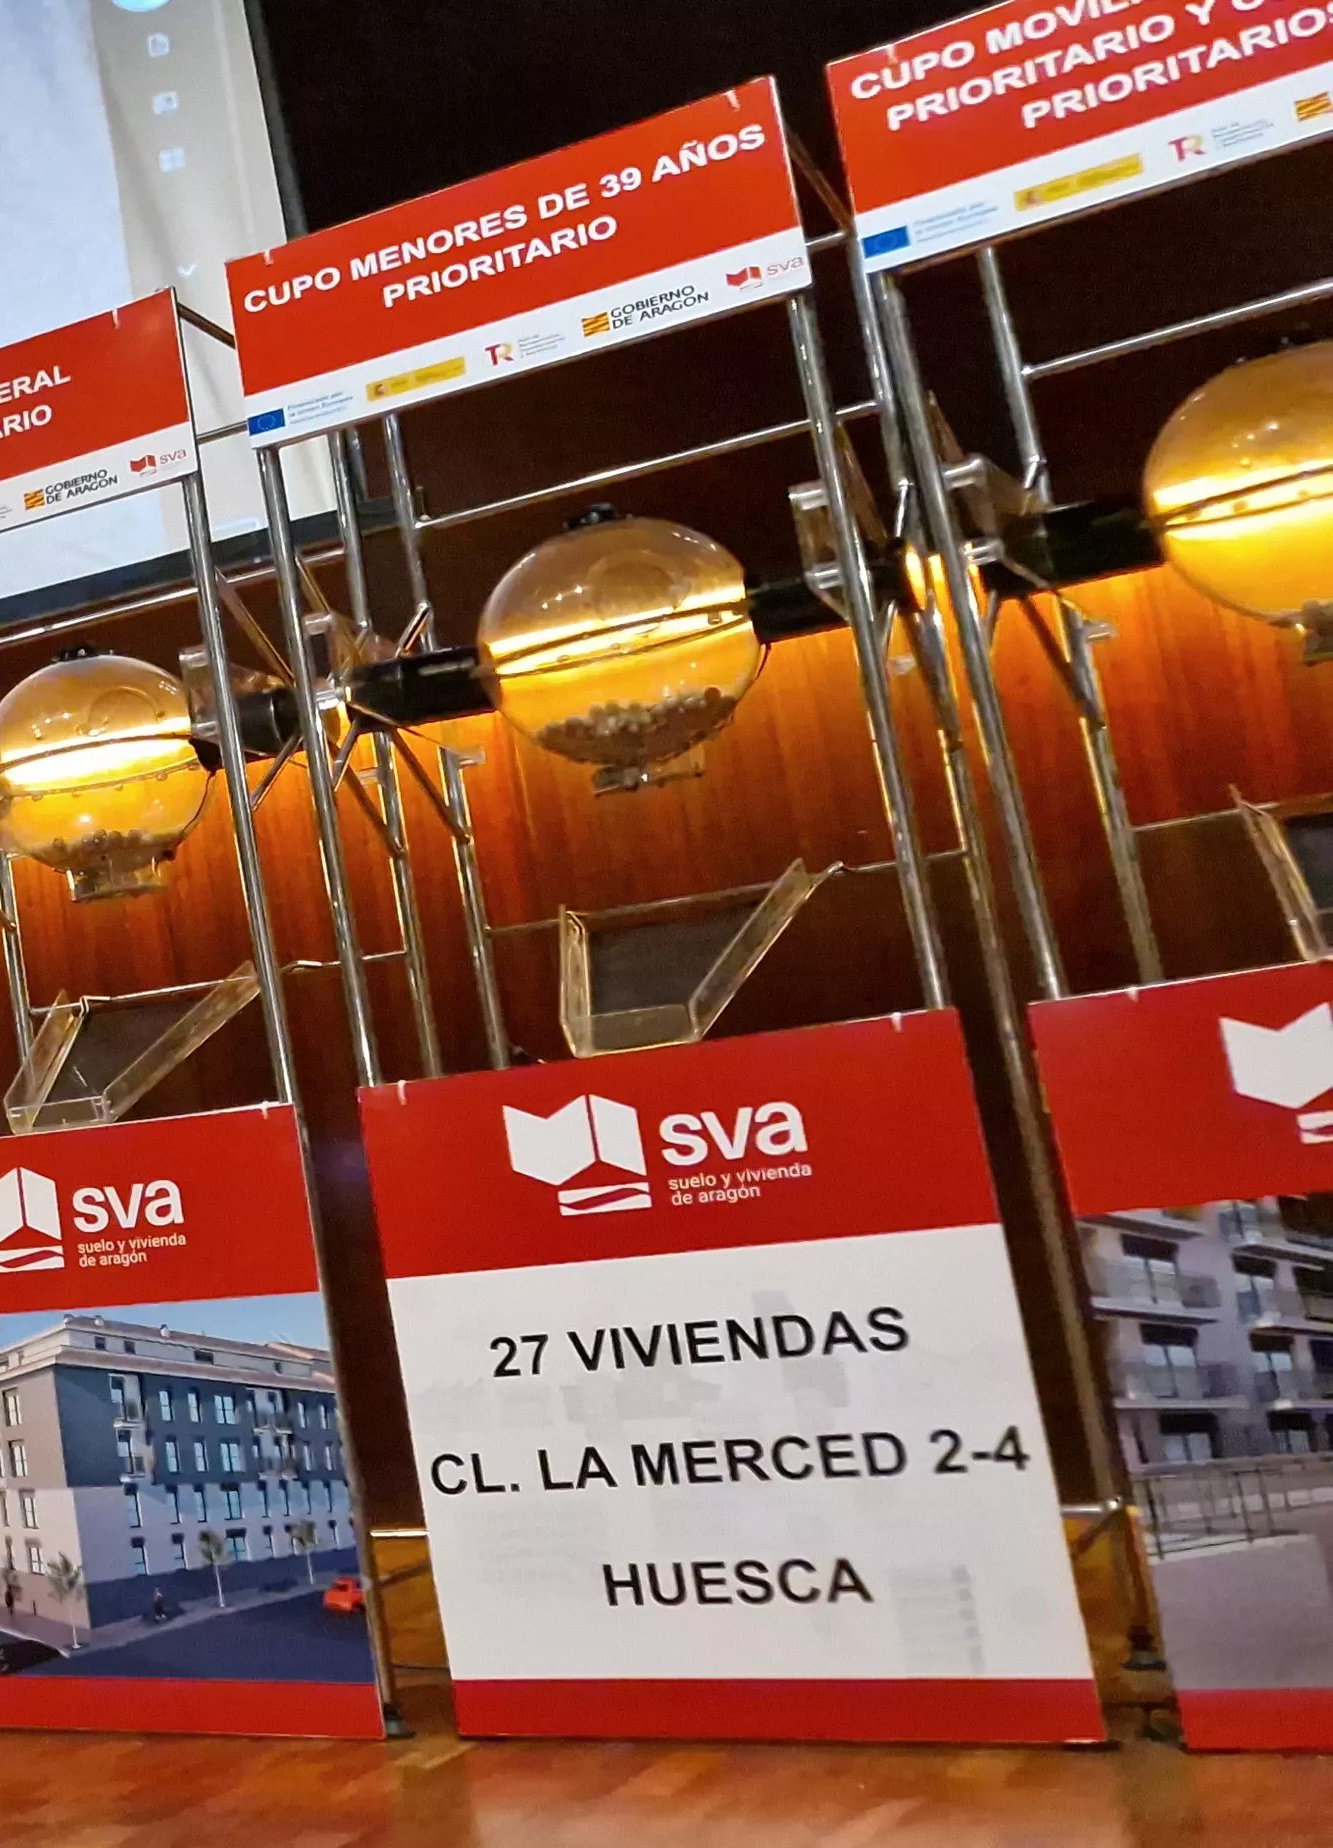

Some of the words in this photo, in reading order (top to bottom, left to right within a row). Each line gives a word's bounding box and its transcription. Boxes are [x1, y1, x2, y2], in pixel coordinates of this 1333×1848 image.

[850, 40, 976, 100] CUPO
[985, 0, 1144, 54] MOVIL
[886, 14, 1175, 131] PRIORITARIO
[1185, 0, 1217, 26] Y
[1021, 0, 1333, 129] PRIORITARIO
[244, 266, 341, 313] CUPO
[349, 204, 528, 281] MENORES
[537, 183, 591, 220] DE
[598, 166, 642, 199] 39
[651, 123, 767, 183] AÑOS
[383, 215, 618, 309] PRIORITARIO
[767, 256, 804, 276] sva
[610, 284, 695, 318] GOBIERNO
[612, 315, 633, 330] DE
[159, 449, 187, 465] sva
[45, 469, 108, 496] GOBIERNO
[46, 493, 62, 505] DE
[659, 1101, 809, 1166] sva
[668, 1172, 717, 1191] suelo
[720, 1173, 731, 1189] y
[735, 1161, 813, 1185] vivienda
[671, 1190, 693, 1206] de
[698, 1183, 761, 1204] aragón
[72, 1179, 185, 1233] sva
[77, 1239, 115, 1254] suelo
[116, 1240, 126, 1254] y
[128, 1233, 187, 1250] vivienda
[79, 1254, 97, 1268] de
[99, 1250, 147, 1267] aragón
[490, 1334, 549, 1378] 27
[568, 1306, 910, 1371] VIVIENDAS
[431, 1453, 520, 1495] CL.
[537, 1446, 618, 1491] LA
[630, 1432, 906, 1486] MERCED
[930, 1425, 1030, 1474] 2-4
[602, 1558, 874, 1607] HUESCA
